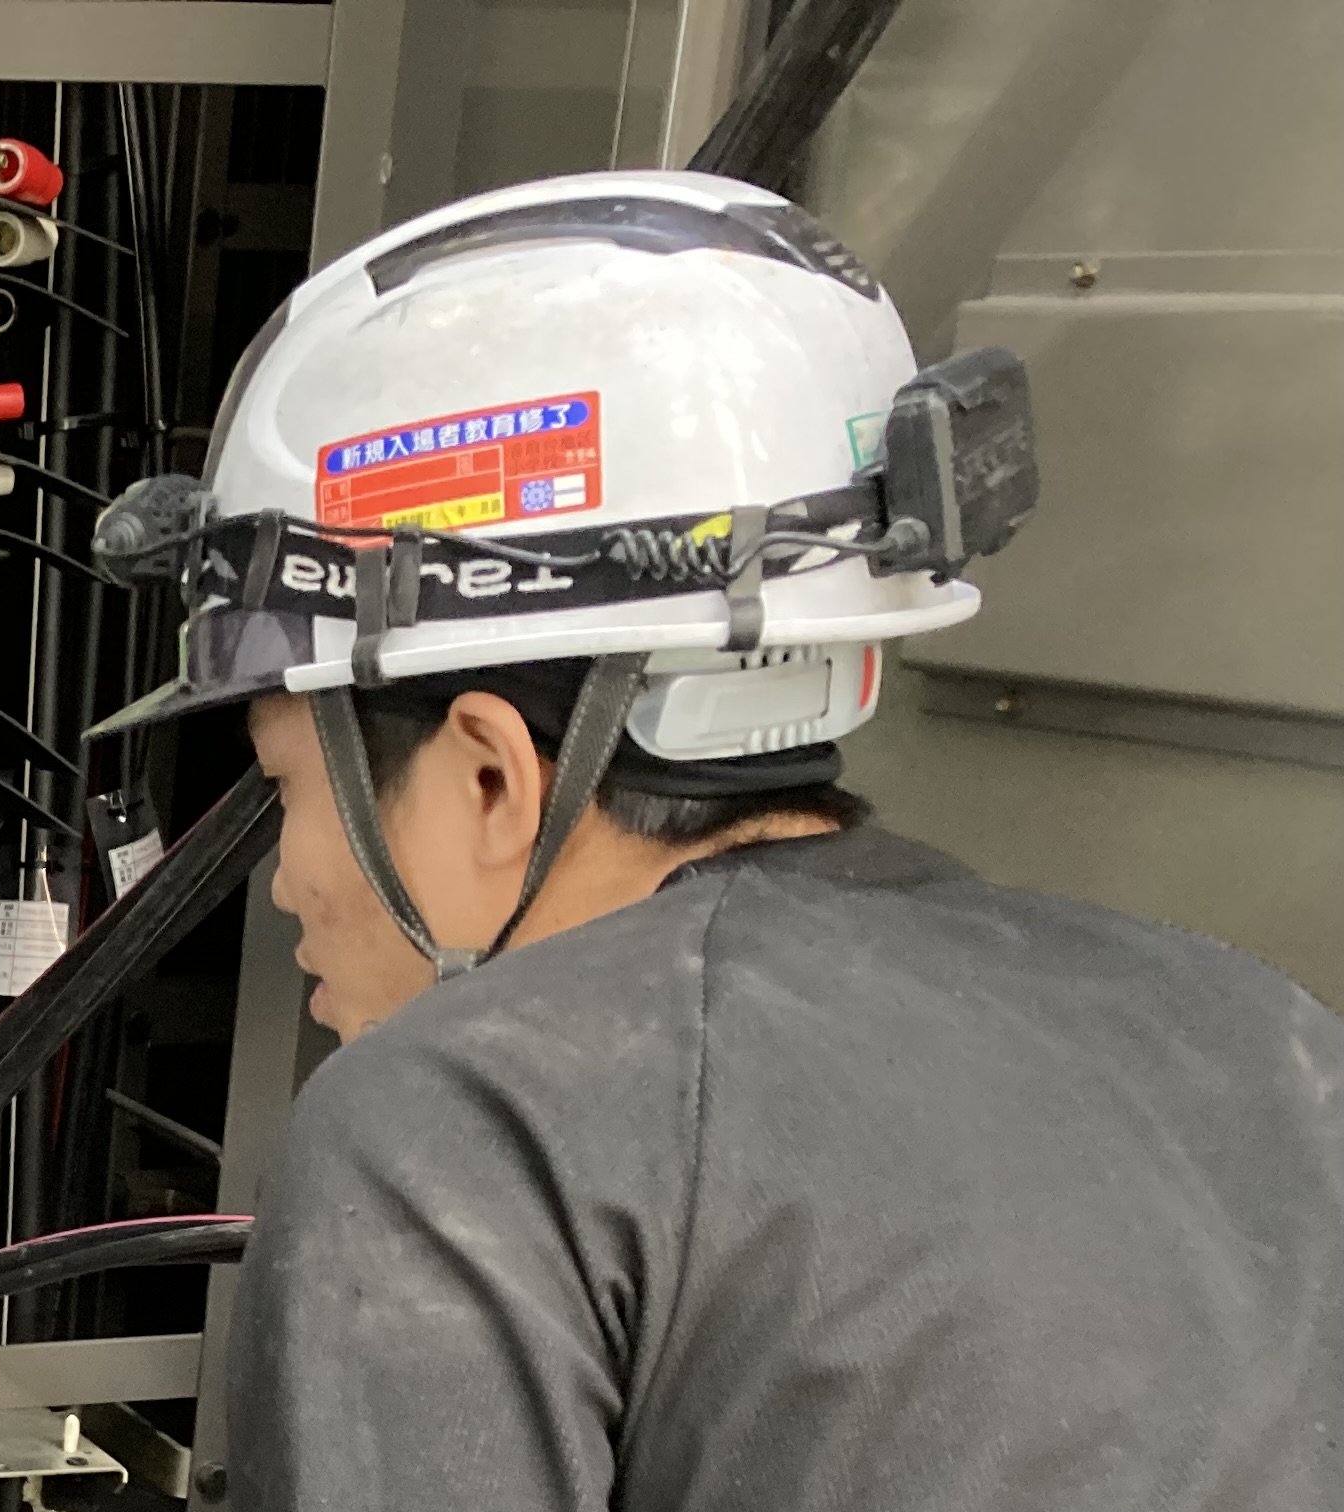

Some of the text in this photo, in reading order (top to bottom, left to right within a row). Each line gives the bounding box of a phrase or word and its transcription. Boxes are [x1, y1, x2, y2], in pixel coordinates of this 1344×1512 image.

[342, 404, 571, 470] 新規入場者教育修了
